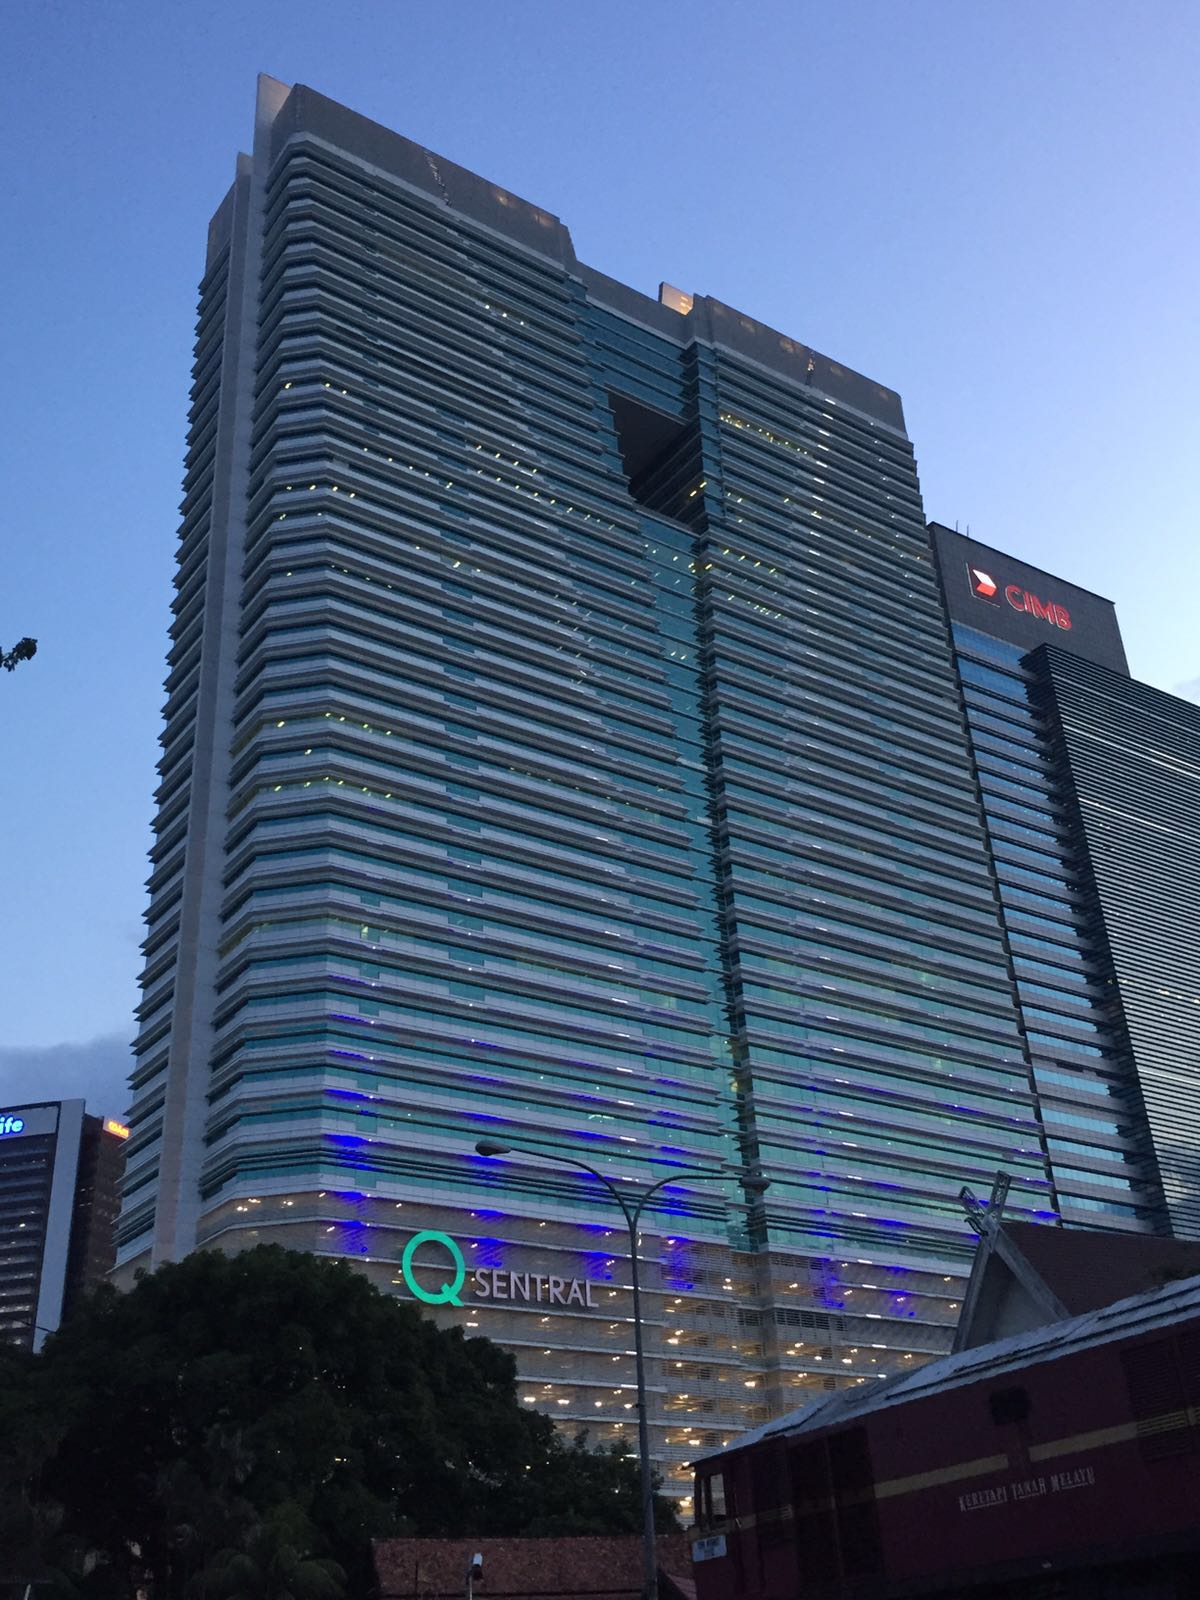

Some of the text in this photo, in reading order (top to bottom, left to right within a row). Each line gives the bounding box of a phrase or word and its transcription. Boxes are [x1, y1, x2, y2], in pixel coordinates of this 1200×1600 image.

[1005, 584, 1072, 631] CIMB
[402, 1229, 599, 1307] Q SENTRAL
[959, 1466, 1096, 1512] KERETAPI TANAH MELAYU
